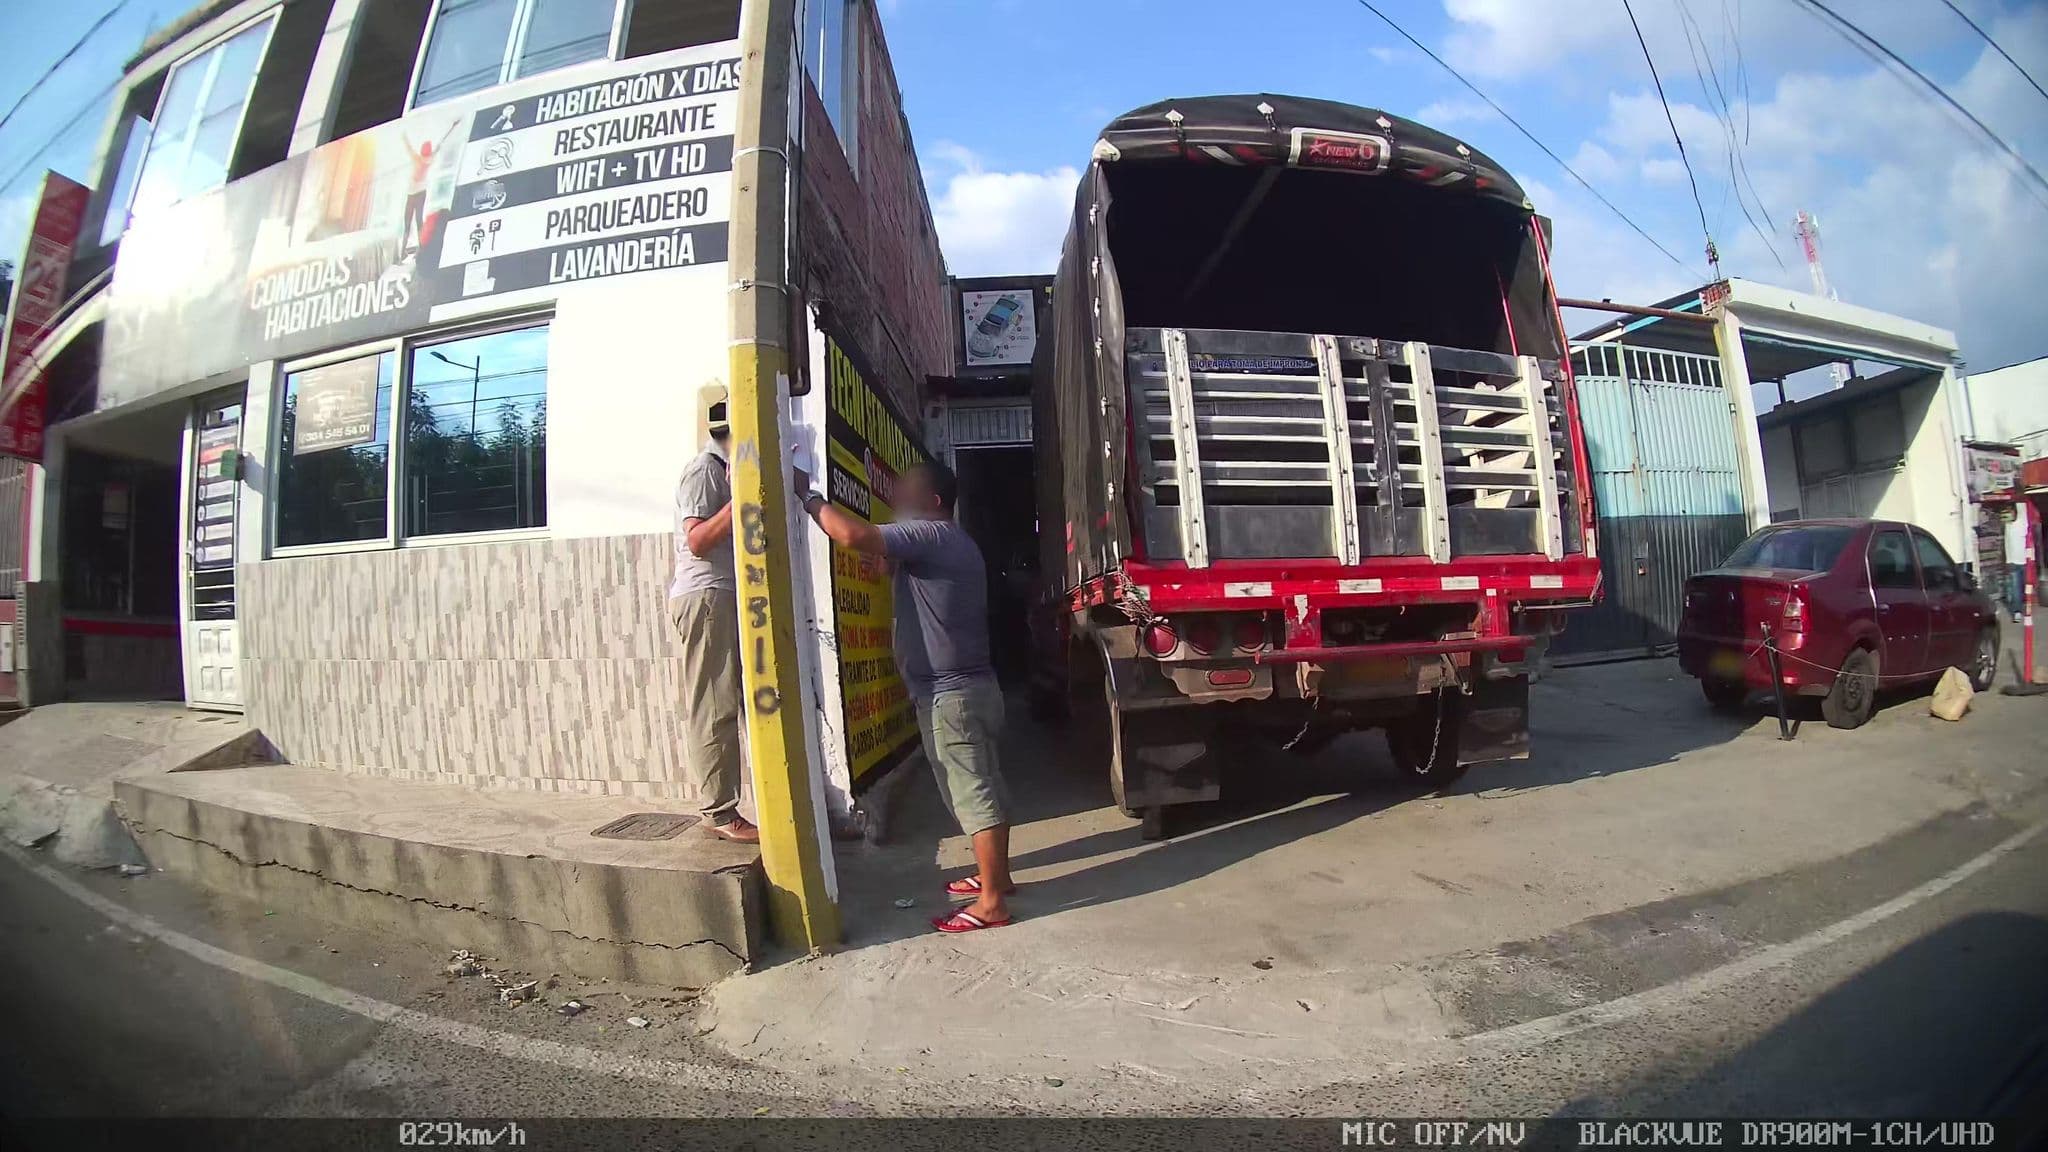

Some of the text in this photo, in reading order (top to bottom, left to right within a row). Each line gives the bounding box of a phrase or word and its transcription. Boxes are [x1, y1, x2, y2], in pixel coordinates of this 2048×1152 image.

[536, 72, 665, 123] HABITACIÓN
[668, 69, 688, 97] X
[554, 103, 717, 156] RESTAURANTE
[556, 143, 707, 195] WIFI + TV HD
[545, 186, 709, 240] PARQUEADERO
[250, 255, 352, 310] COMODAS
[549, 228, 696, 283] LAVANDERÍA
[263, 273, 412, 341] HABITACIONES
[827, 335, 866, 440] TECNI
[833, 447, 870, 516] SERVICIOS
[840, 587, 872, 616] LEGALIDAD
